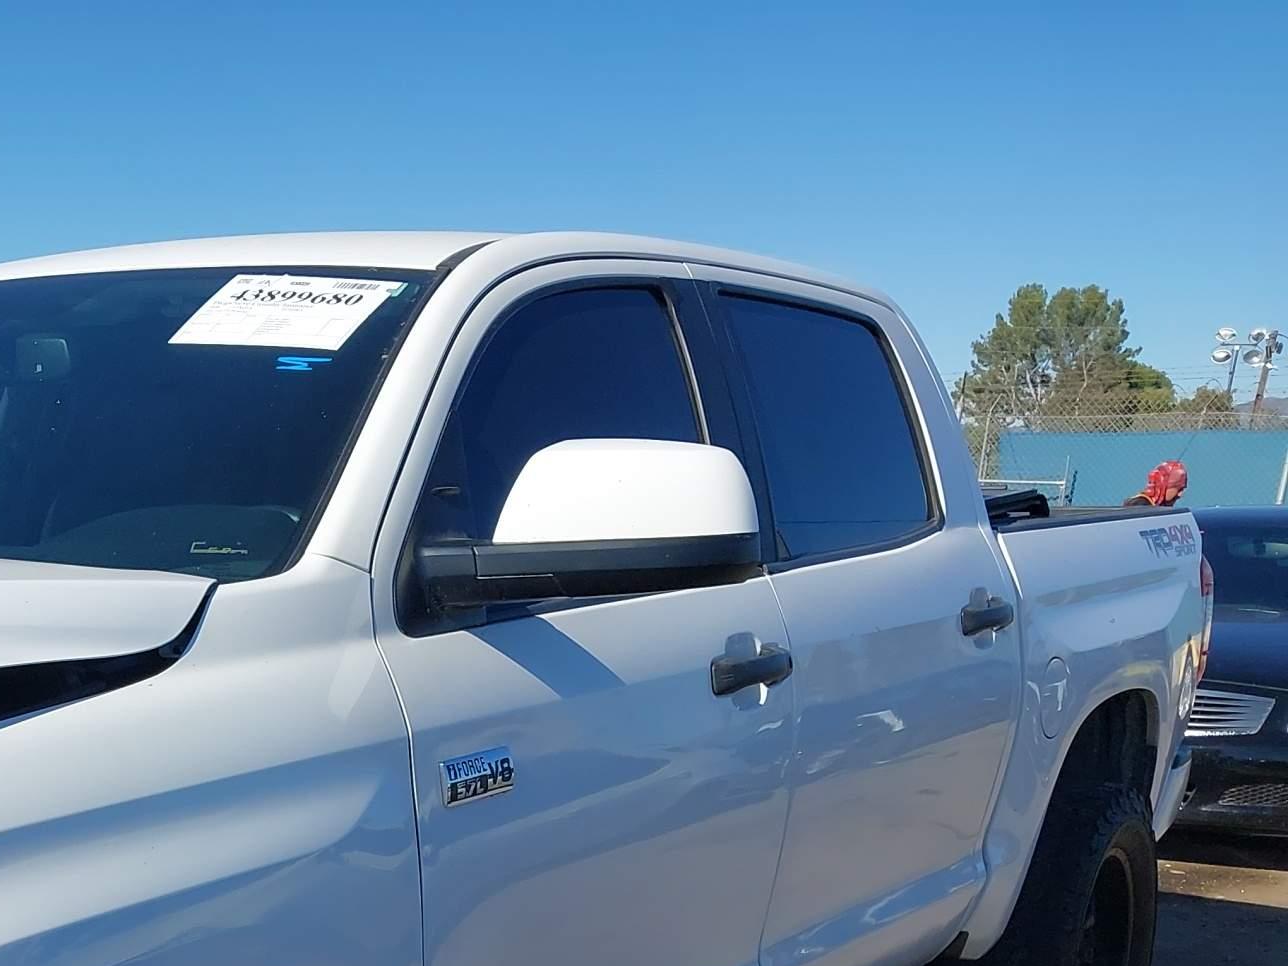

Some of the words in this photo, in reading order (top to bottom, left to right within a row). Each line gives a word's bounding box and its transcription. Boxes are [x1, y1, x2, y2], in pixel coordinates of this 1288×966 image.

[229, 288, 364, 306] 43899680
[1139, 527, 1173, 559] TRD
[487, 757, 514, 785] V8
